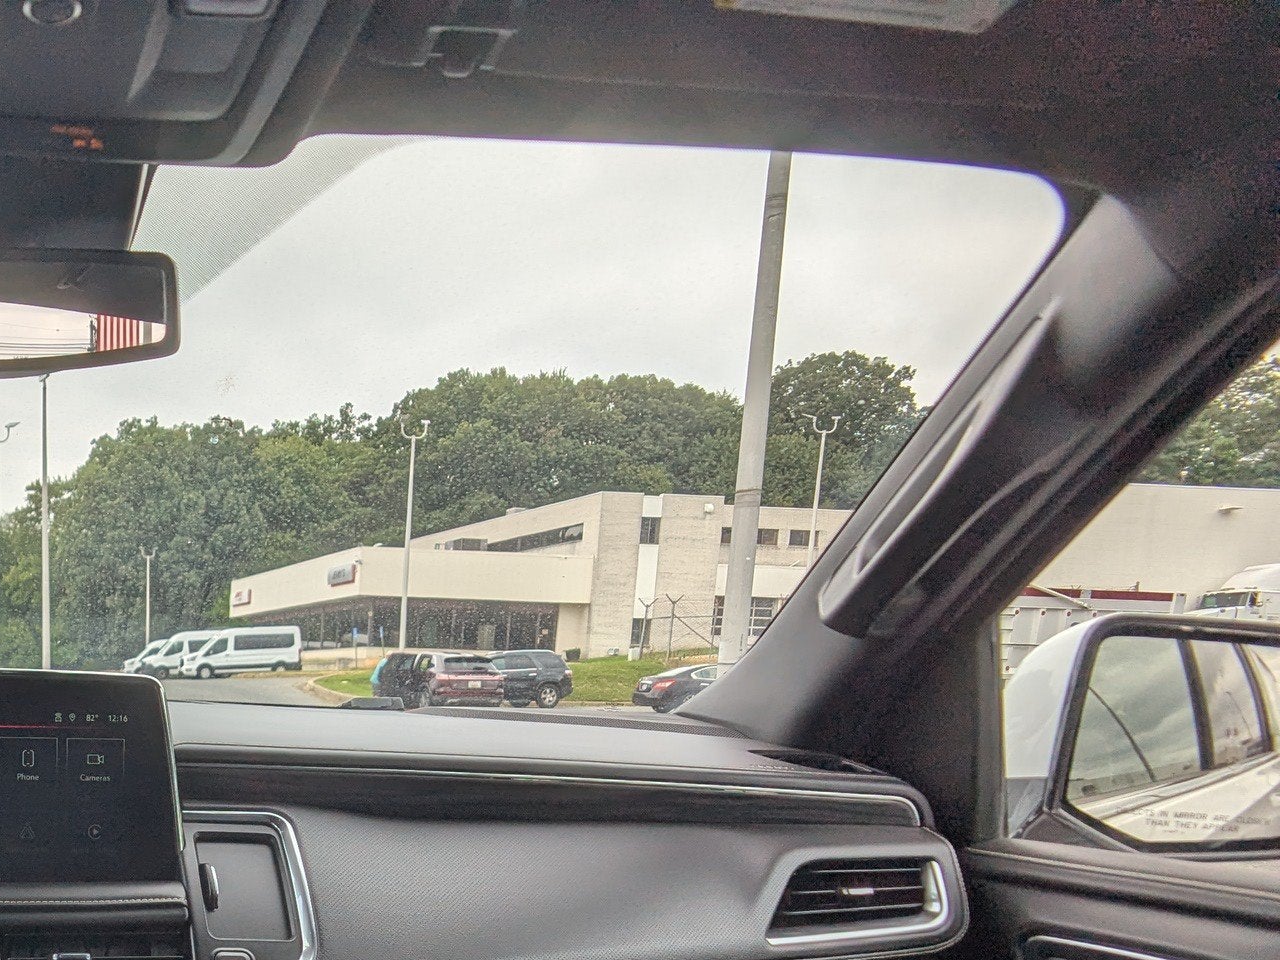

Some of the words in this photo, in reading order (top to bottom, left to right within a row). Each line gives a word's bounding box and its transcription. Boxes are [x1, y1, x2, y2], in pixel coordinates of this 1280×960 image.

[108, 714, 128, 723] 12:16
[16, 773, 40, 781] Phone
[80, 774, 111, 782] Cameras
[1173, 811, 1210, 821] MIRROR
